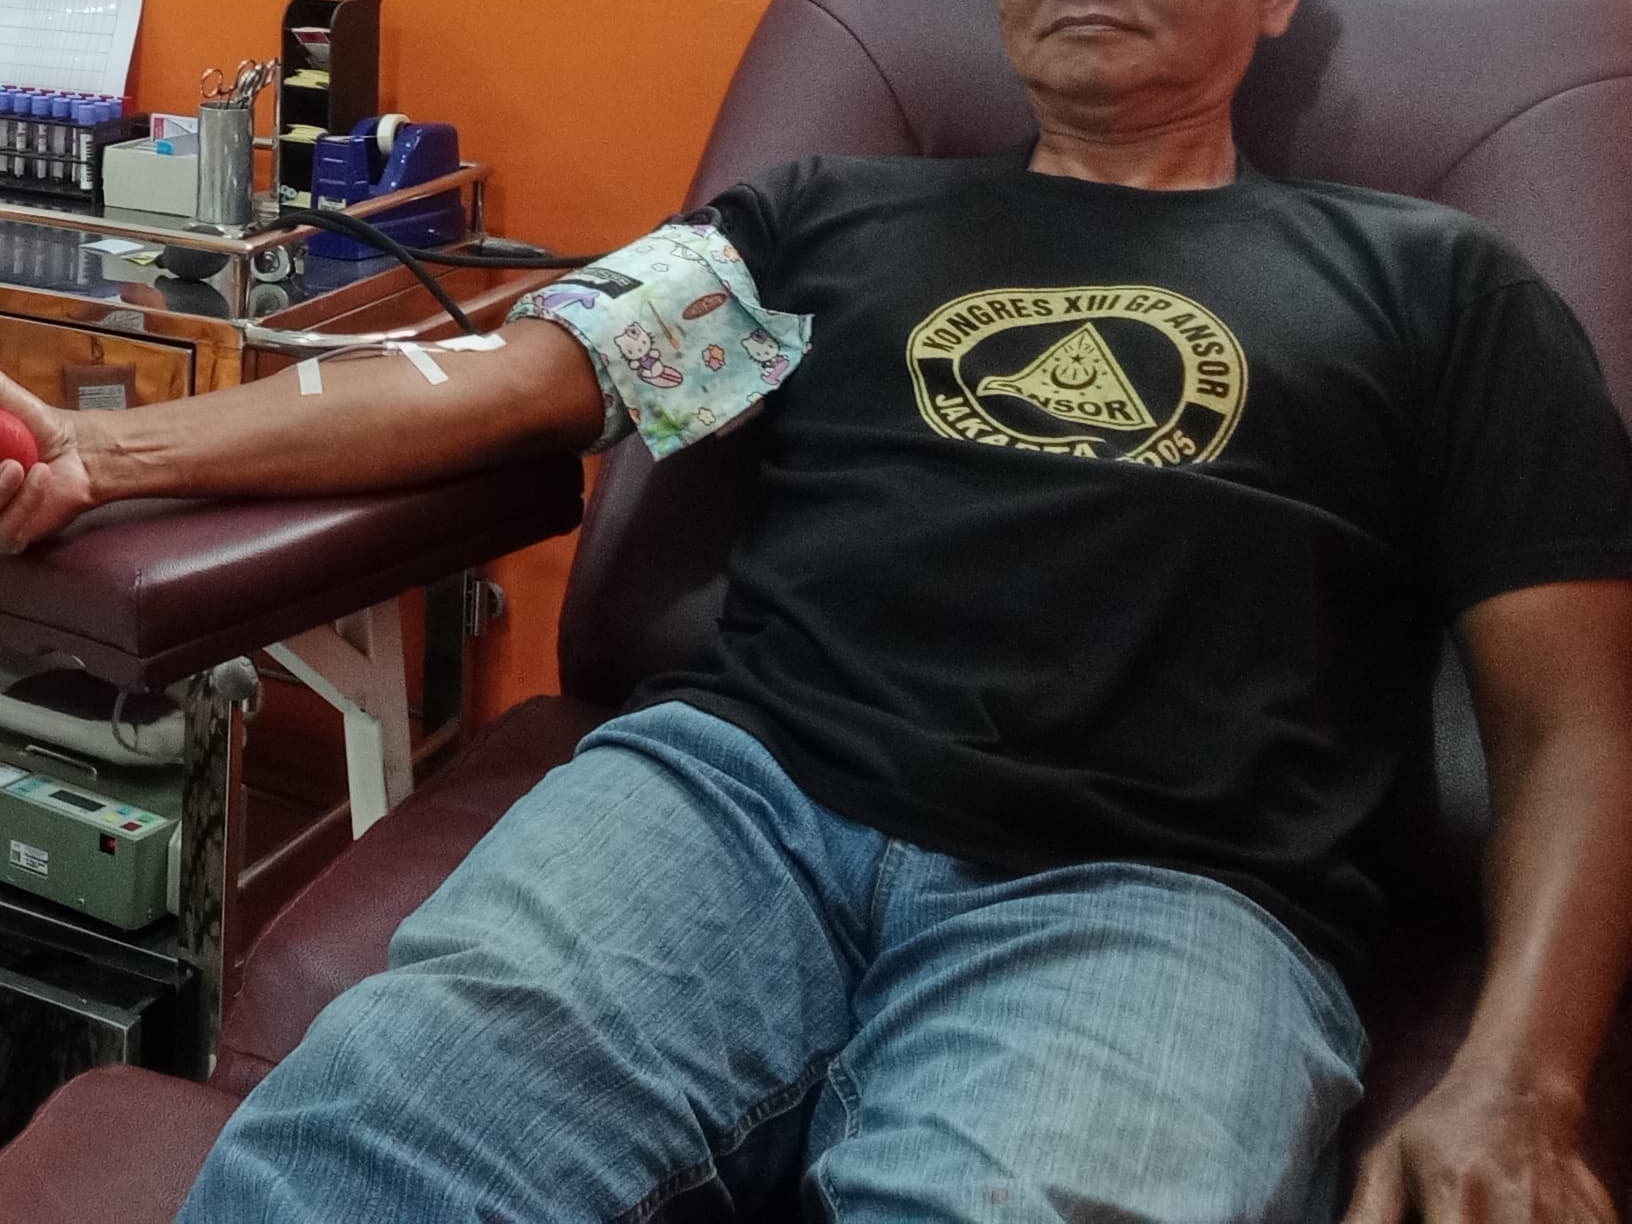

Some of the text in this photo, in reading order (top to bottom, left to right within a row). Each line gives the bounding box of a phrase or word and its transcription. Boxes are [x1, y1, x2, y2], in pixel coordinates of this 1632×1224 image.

[923, 294, 1230, 399] KONGRES XIII GP ANSOR
[1013, 384, 1135, 422] NSOR
[1116, 429, 1196, 468] 005
